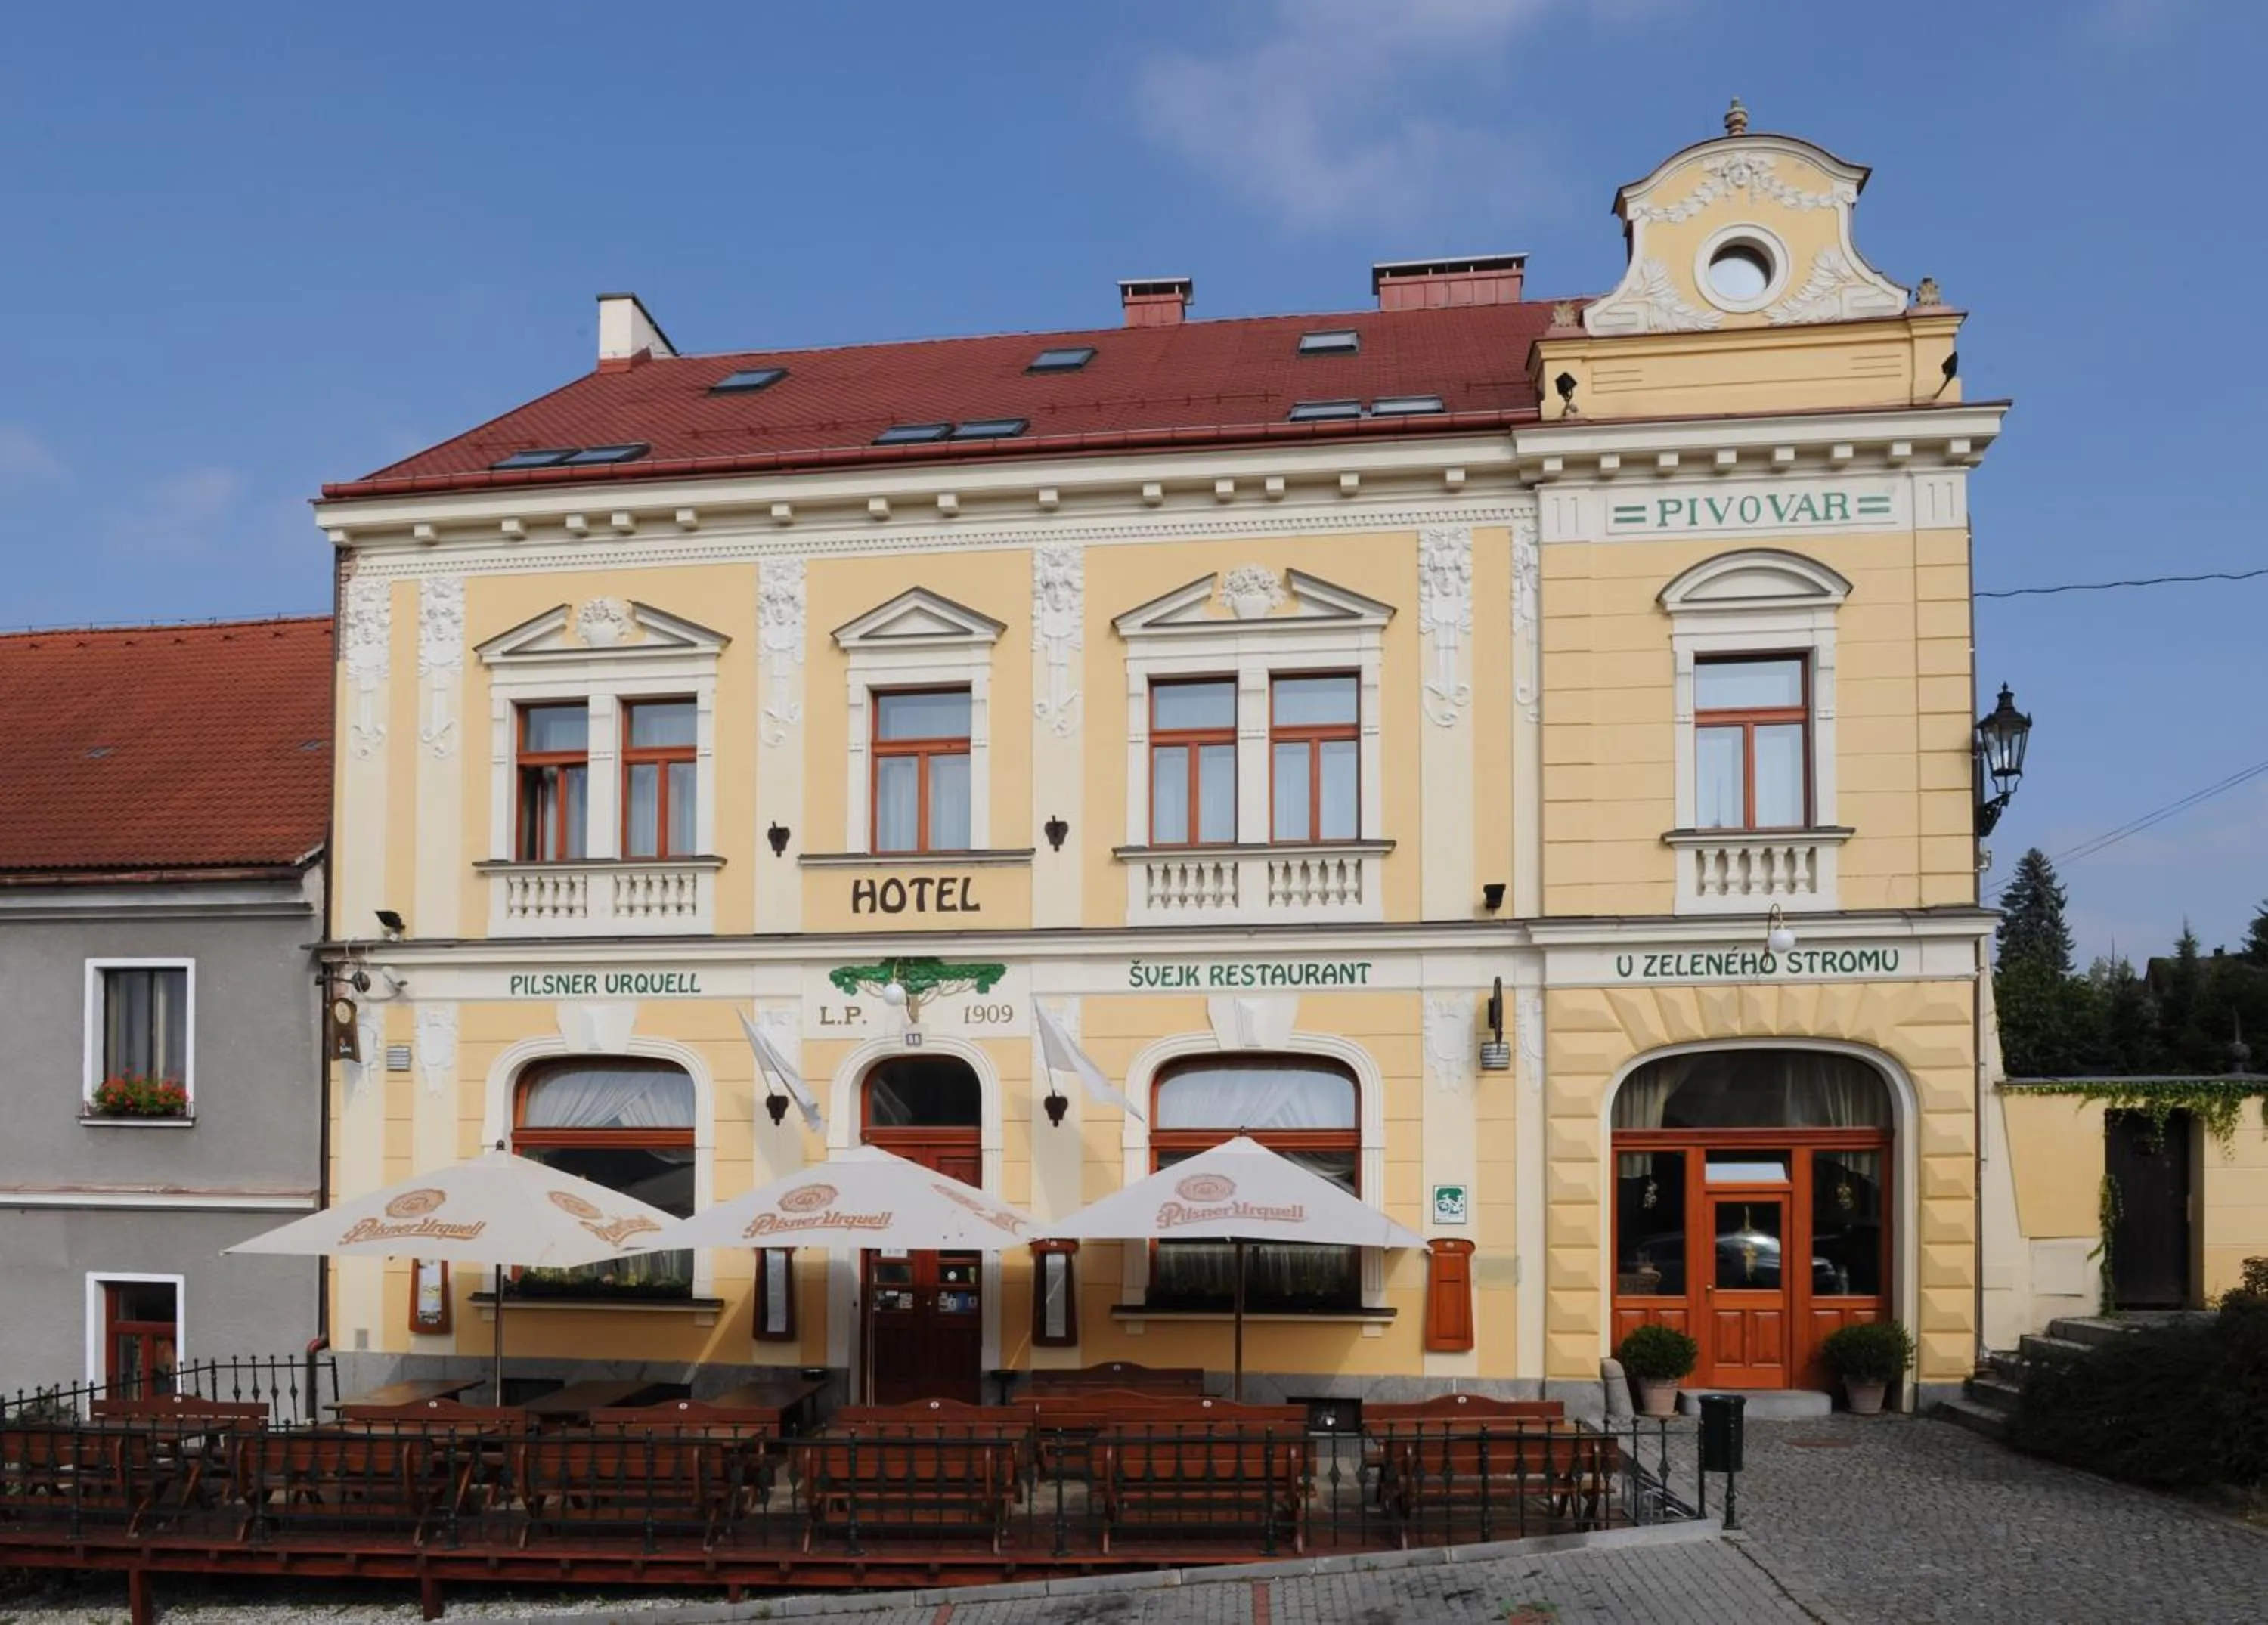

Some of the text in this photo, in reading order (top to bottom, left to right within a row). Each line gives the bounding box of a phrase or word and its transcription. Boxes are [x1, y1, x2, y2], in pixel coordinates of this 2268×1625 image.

[1656, 492, 1851, 528] PIVOVAR
[851, 877, 981, 913] HOTEL
[1129, 959, 1372, 988] ŠVEJK RESTAURANT
[1616, 946, 1898, 977] U ZELENÉHO STROMU
[510, 973, 702, 995] PILSNER URQUELL
[820, 1006, 867, 1025] L.P.
[963, 1004, 1014, 1023] 1909
[742, 1210, 893, 1239] Pilsner Urquell
[1156, 1201, 1304, 1229] Pilsner Urquell
[339, 1217, 487, 1246] Pilsner Urquell
